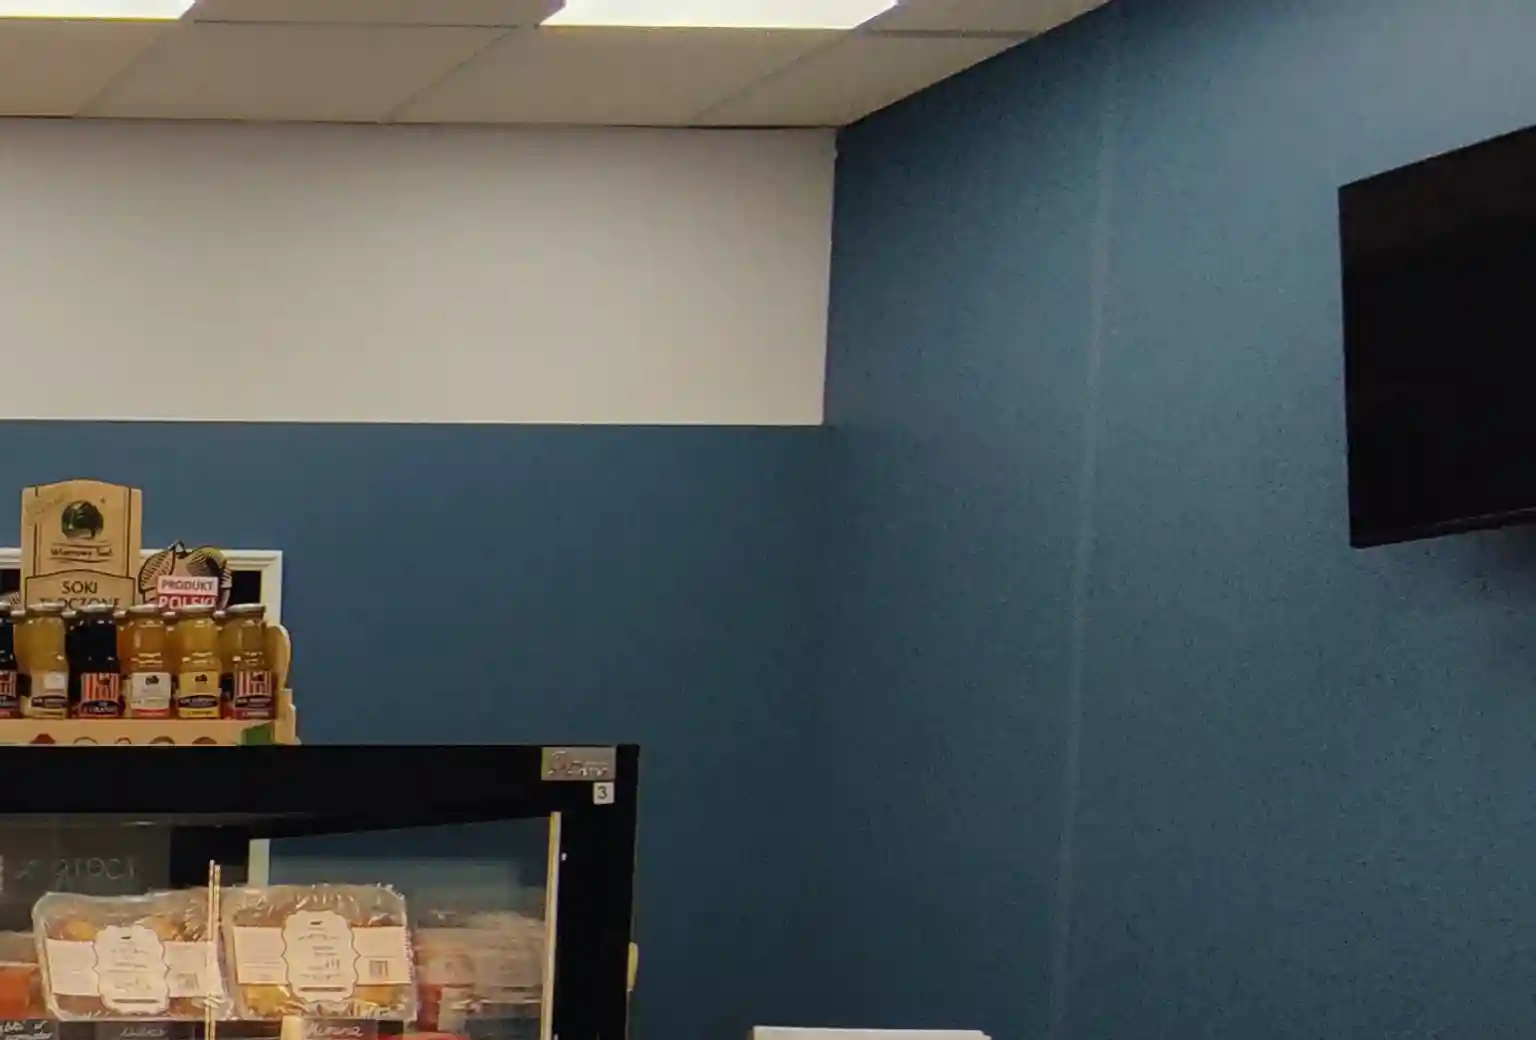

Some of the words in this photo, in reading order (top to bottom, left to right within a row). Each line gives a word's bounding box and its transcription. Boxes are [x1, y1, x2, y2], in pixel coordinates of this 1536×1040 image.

[61, 580, 98, 594] SOKI
[161, 579, 214, 591] PRODUKT
[40, 597, 121, 611] OCZONE
[597, 785, 608, 799] 3
